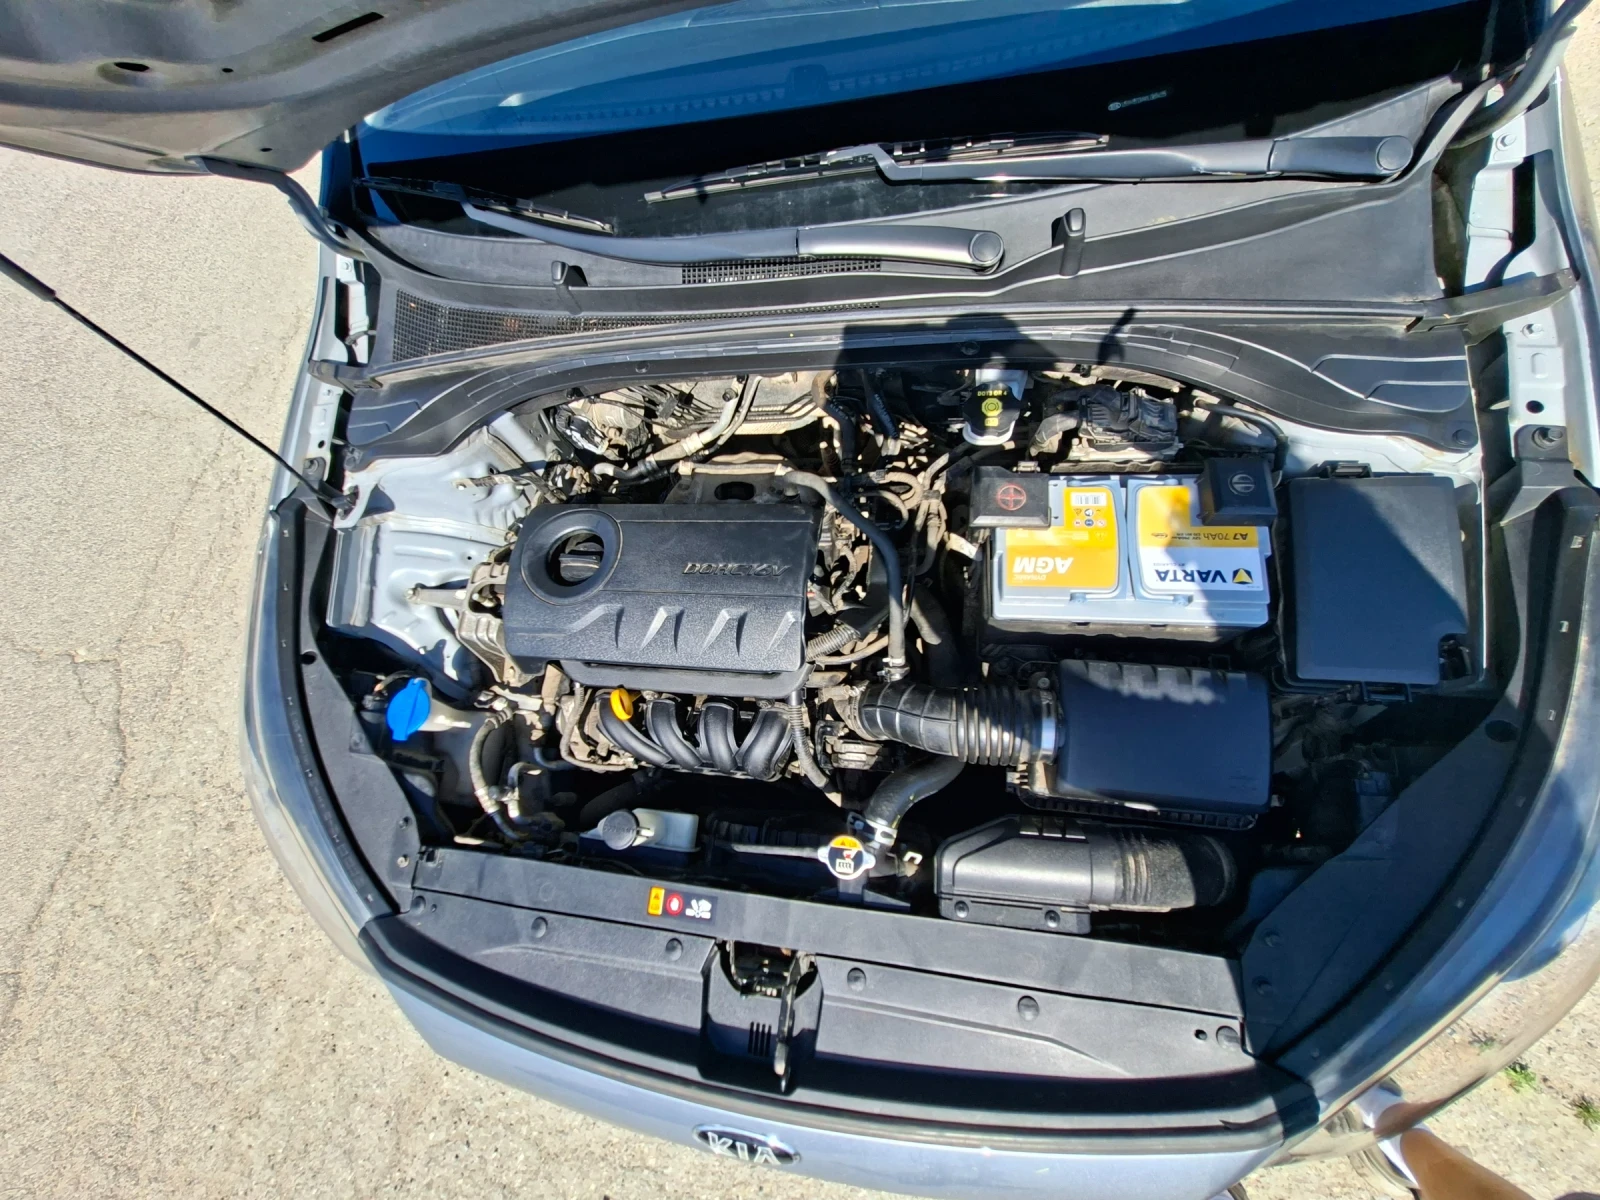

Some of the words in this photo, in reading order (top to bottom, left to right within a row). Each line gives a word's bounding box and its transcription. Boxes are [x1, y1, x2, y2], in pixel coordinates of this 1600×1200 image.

[1203, 532, 1230, 541] 70Ah
[1233, 532, 1248, 541] A7
[1013, 556, 1074, 574] AGM
[1155, 569, 1227, 584] VARTA
[708, 1131, 781, 1165] KIA
